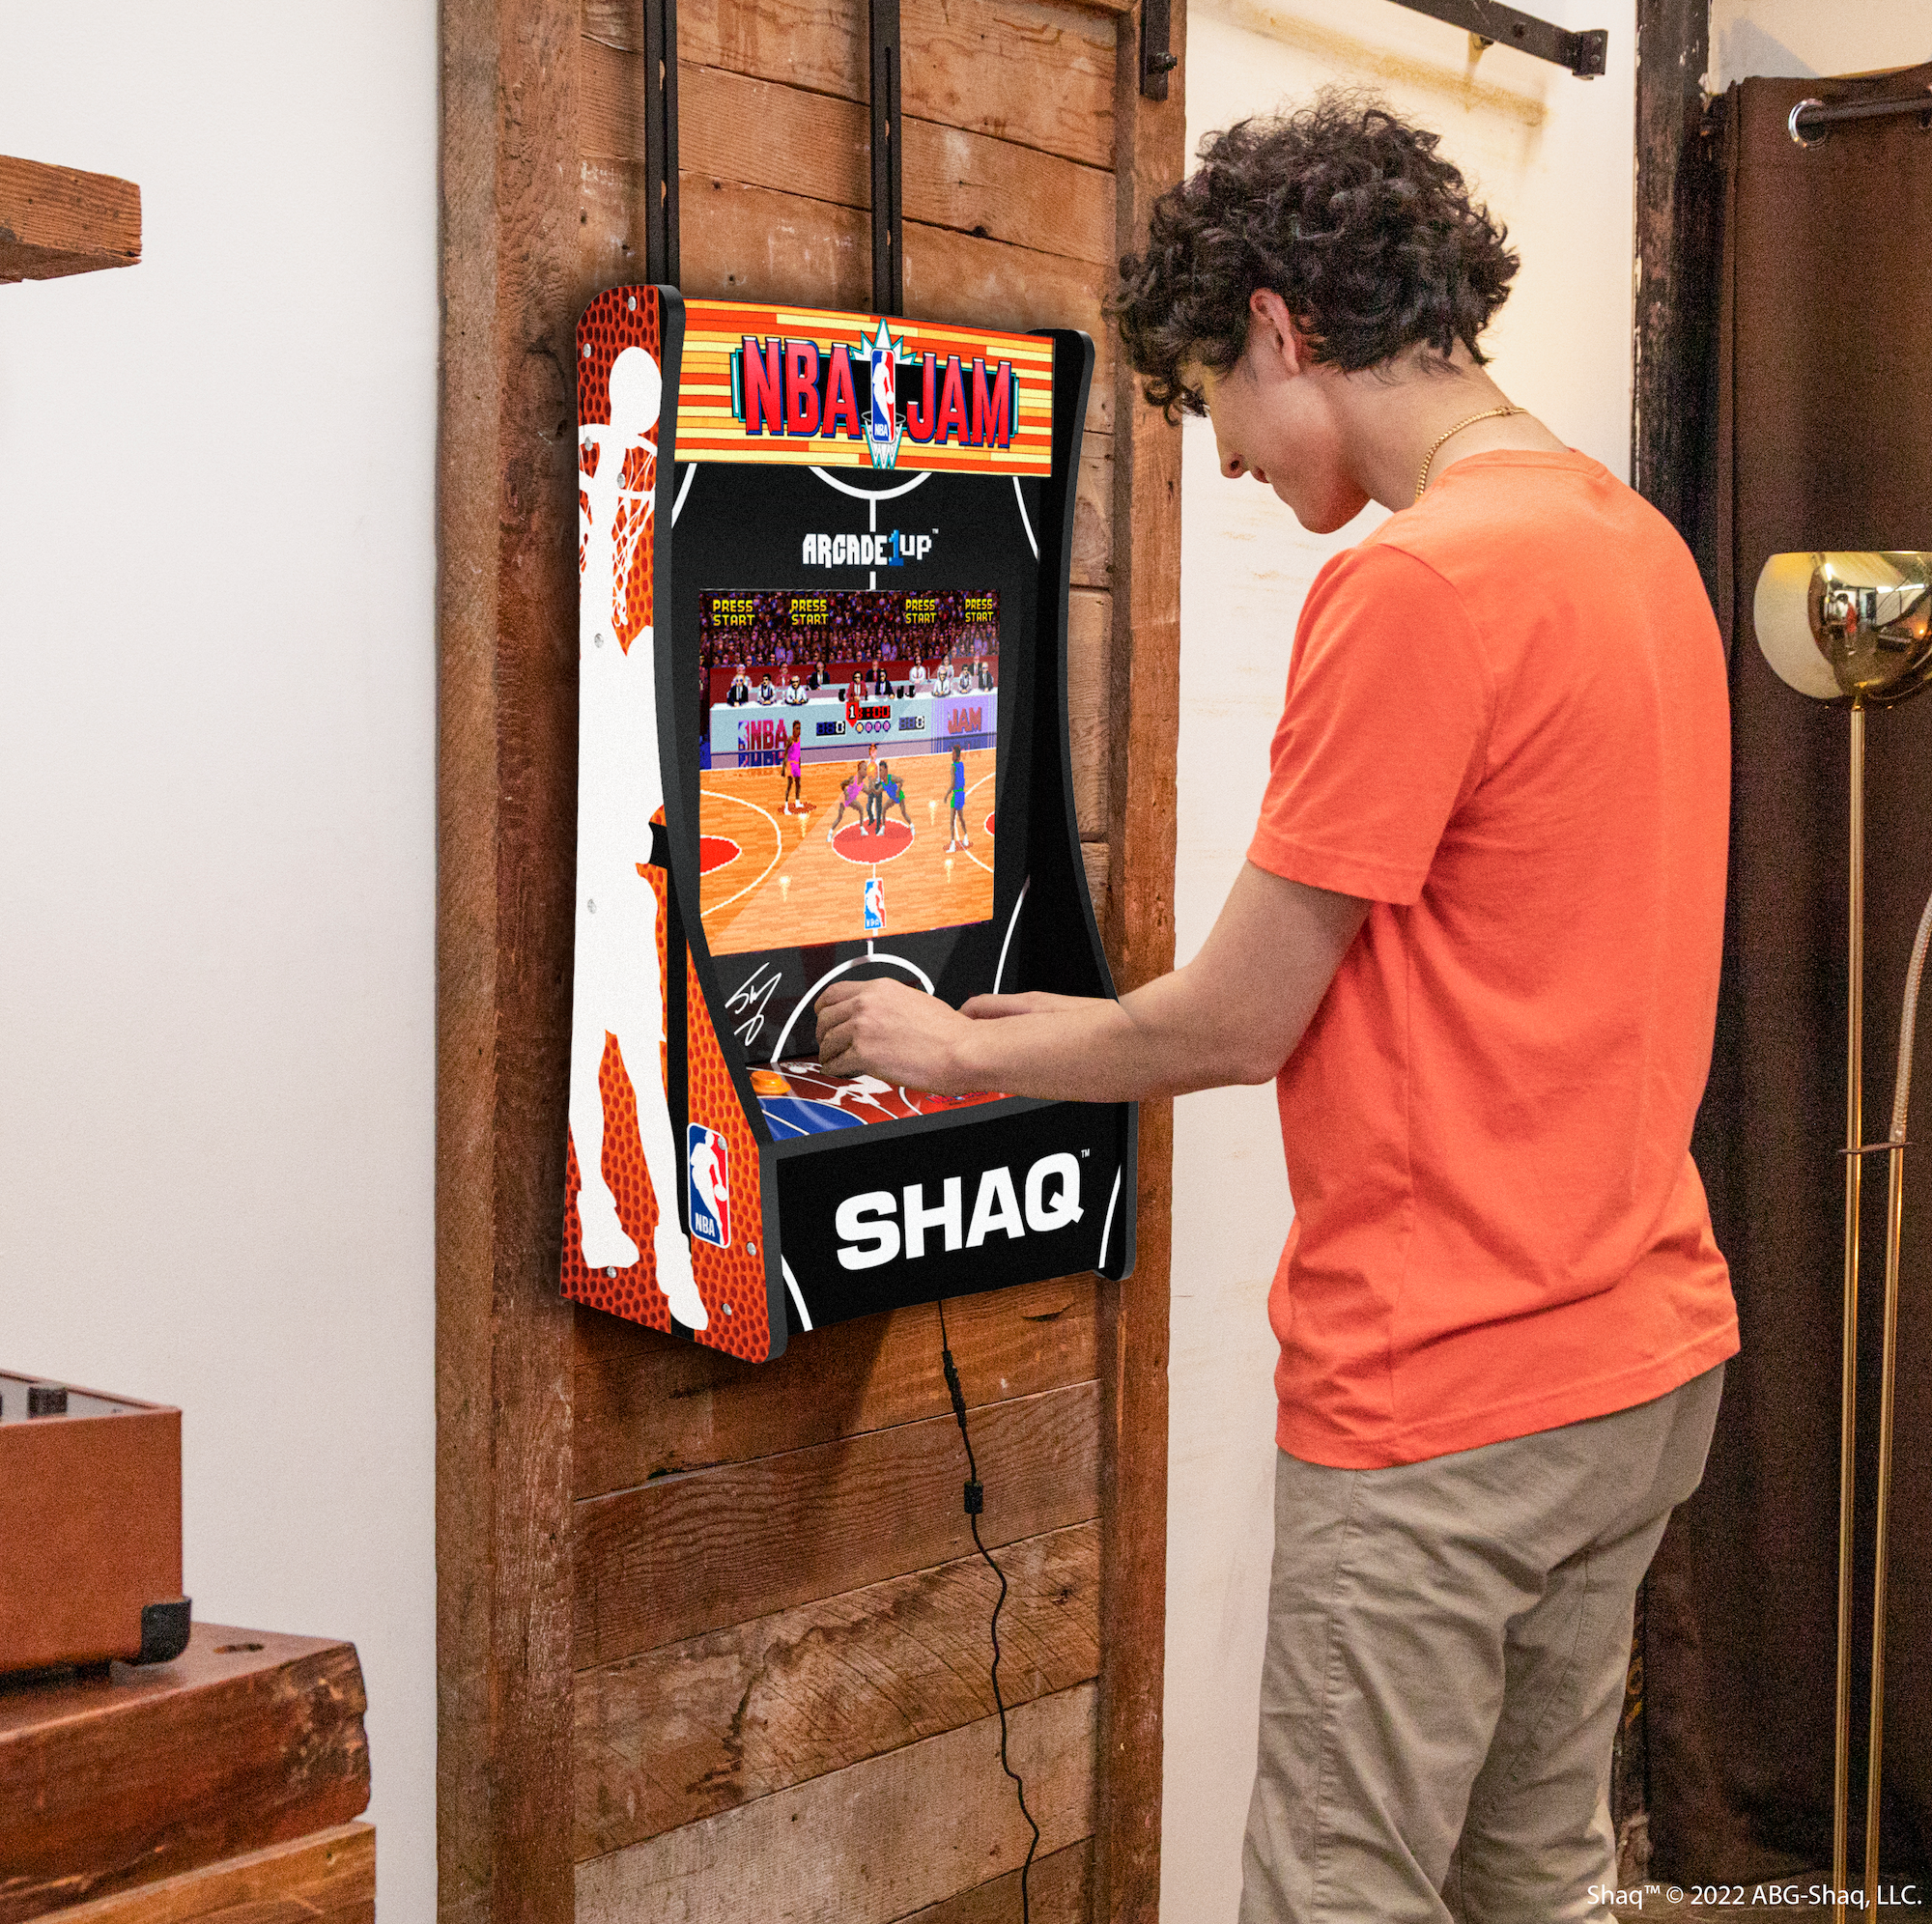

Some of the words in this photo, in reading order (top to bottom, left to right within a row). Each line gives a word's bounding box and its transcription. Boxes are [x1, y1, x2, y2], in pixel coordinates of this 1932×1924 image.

[741, 335, 864, 440] NBA
[906, 352, 1012, 449] JAM
[874, 423, 889, 437] NBA
[713, 599, 753, 612] PRESS
[791, 599, 827, 612] PRESS
[905, 599, 935, 611] PRESS
[965, 598, 993, 610] PRESS
[713, 614, 755, 626] START
[791, 613, 829, 626] START
[905, 612, 937, 624] START
[965, 611, 994, 623] START
[948, 706, 982, 735] JAM
[751, 718, 788, 750] NBA
[835, 1152, 1085, 1270] SHAQ
[695, 1212, 716, 1237] NBA
